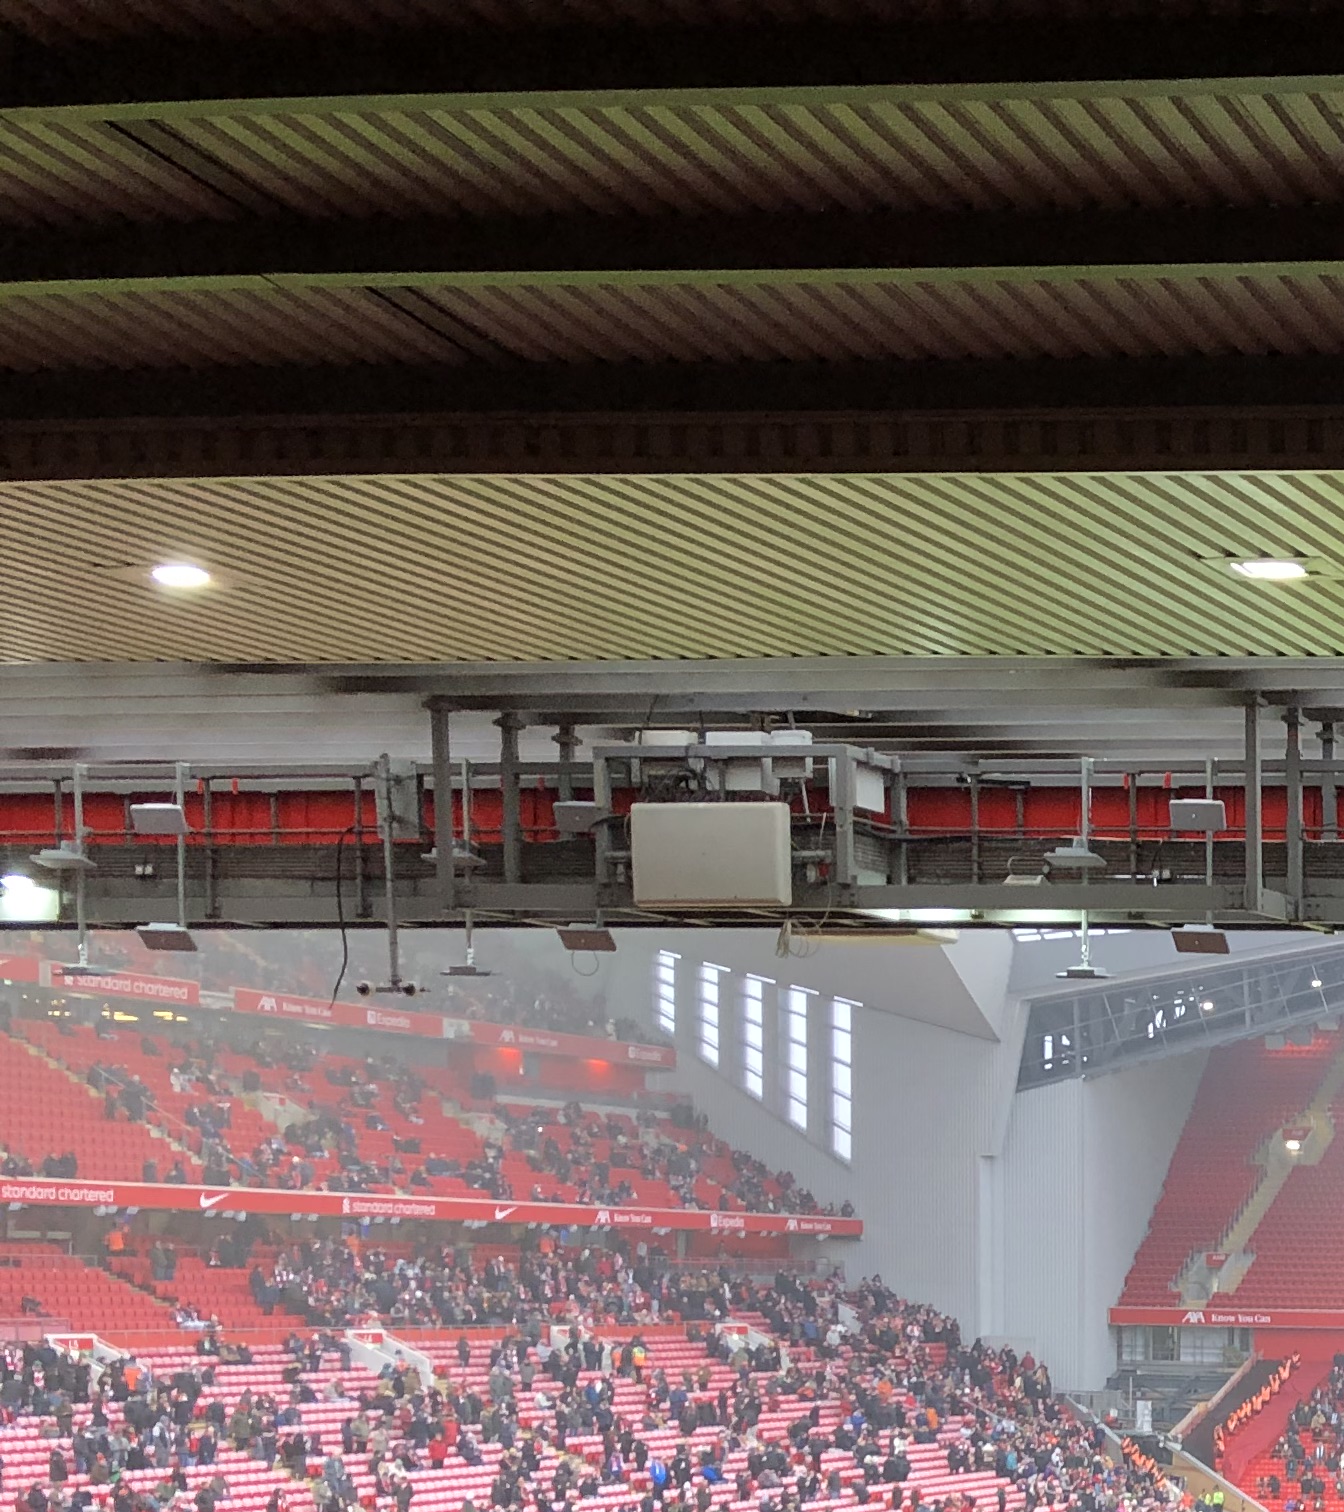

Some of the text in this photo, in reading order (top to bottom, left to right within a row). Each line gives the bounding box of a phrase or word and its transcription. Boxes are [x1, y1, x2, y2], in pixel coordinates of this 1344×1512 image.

[133, 981, 188, 1000] chartered
[1, 1185, 114, 1202] standard chartered
[352, 1201, 436, 1216] standard chartered
[717, 1215, 745, 1229] Expedia
[1212, 1313, 1271, 1325] Know You Can
